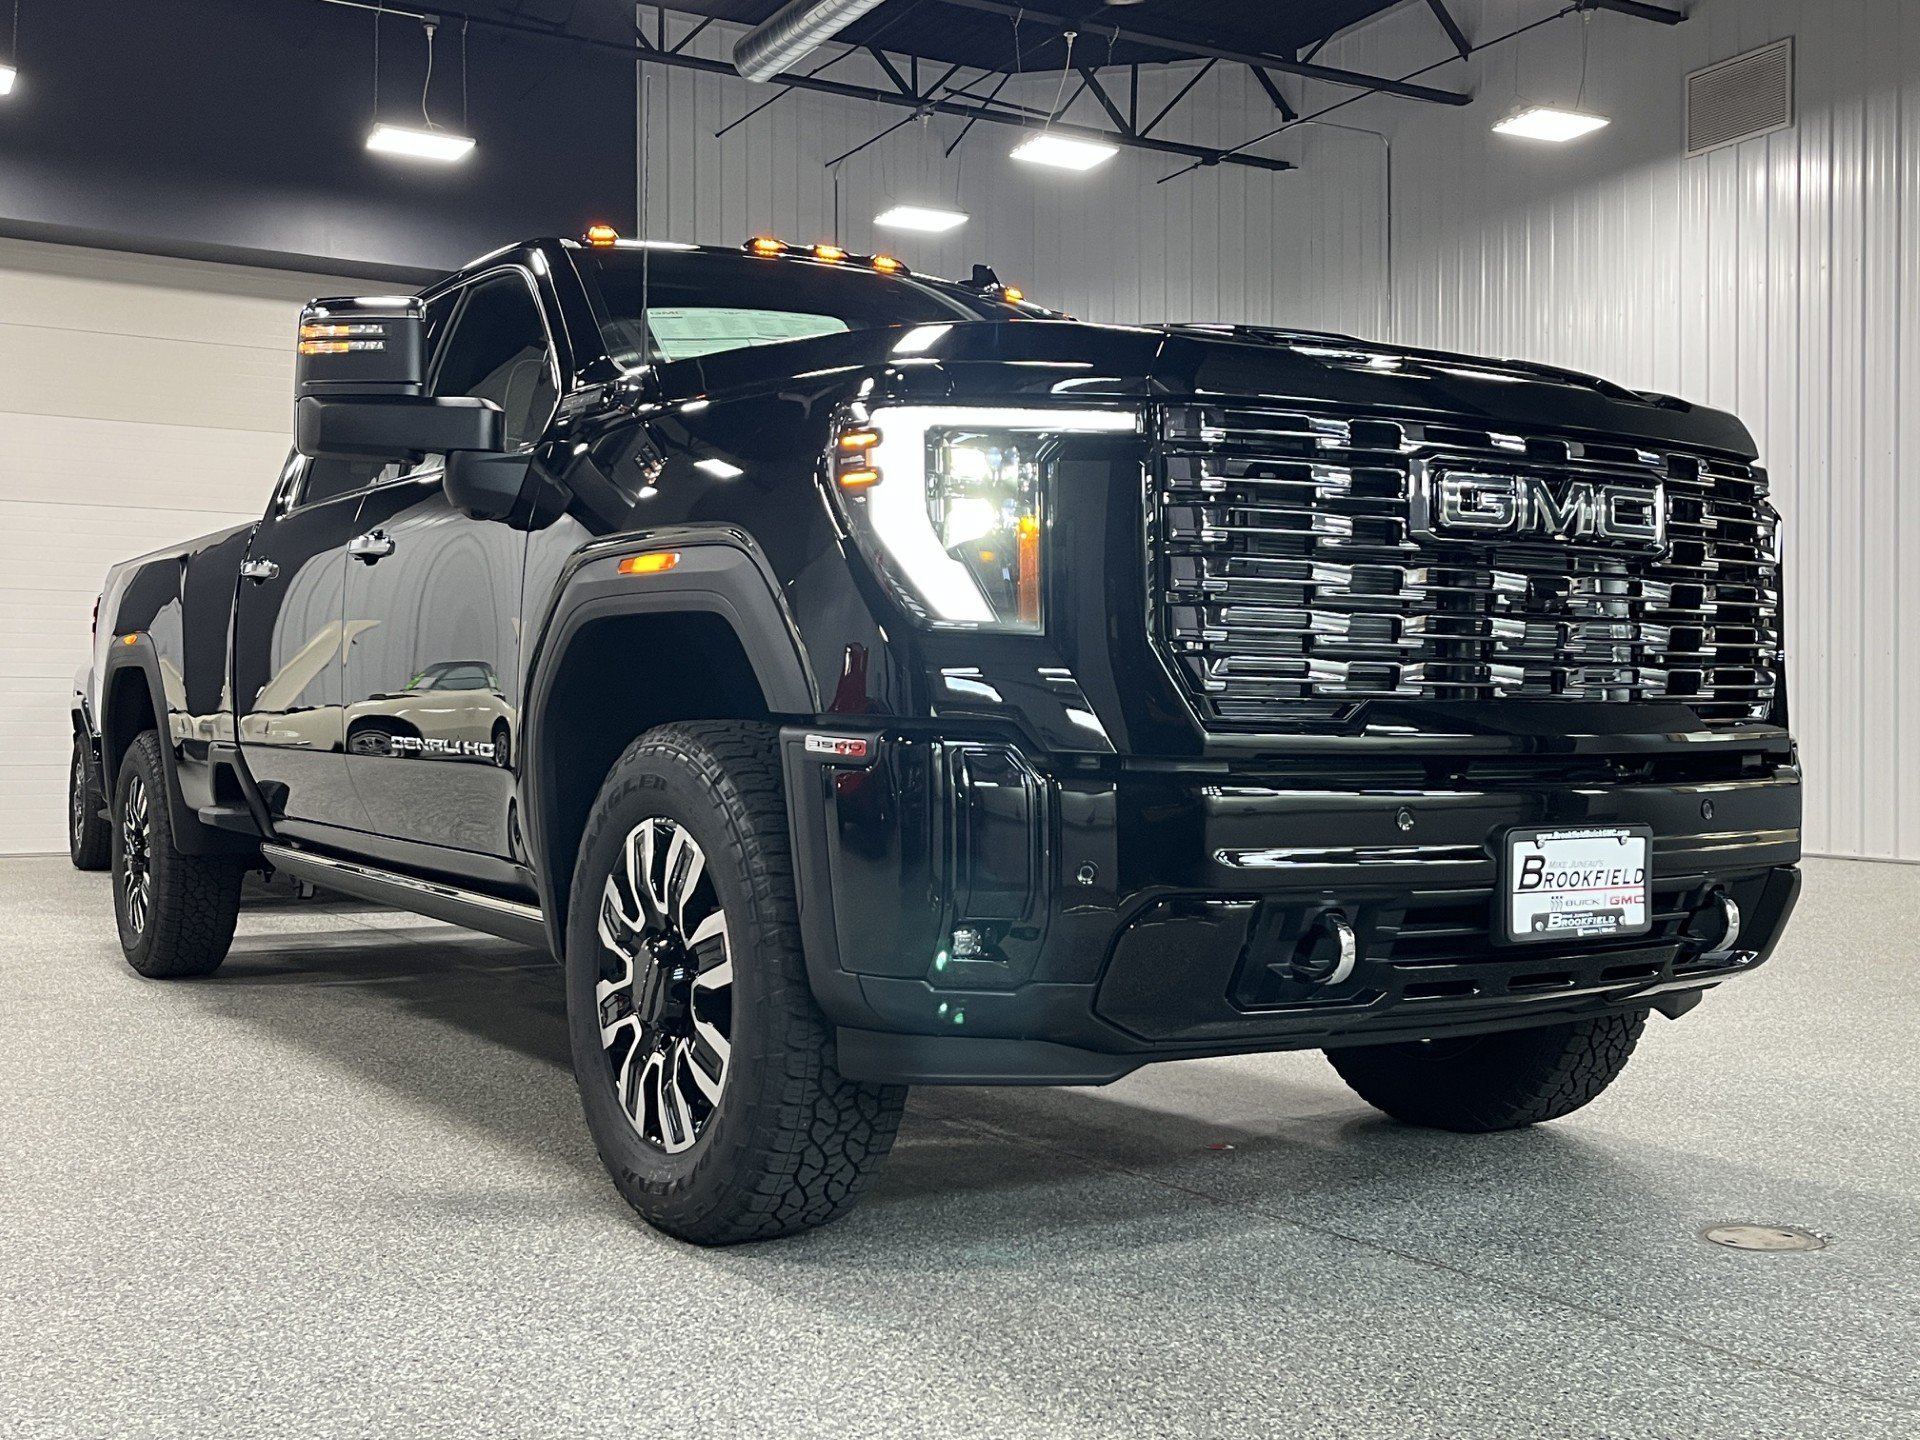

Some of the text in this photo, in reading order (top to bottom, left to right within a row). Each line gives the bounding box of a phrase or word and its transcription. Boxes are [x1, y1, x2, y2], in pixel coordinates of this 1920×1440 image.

[1437, 470, 1661, 540] GMC
[390, 735, 495, 757] DENALI HD
[1518, 855, 1645, 890] BROOKFIELD
[1547, 860, 1604, 869] MIKE JUNEAU'S
[1565, 895, 1645, 907] BUICK GMC
[1547, 912, 1616, 928] BROOKFIELD
